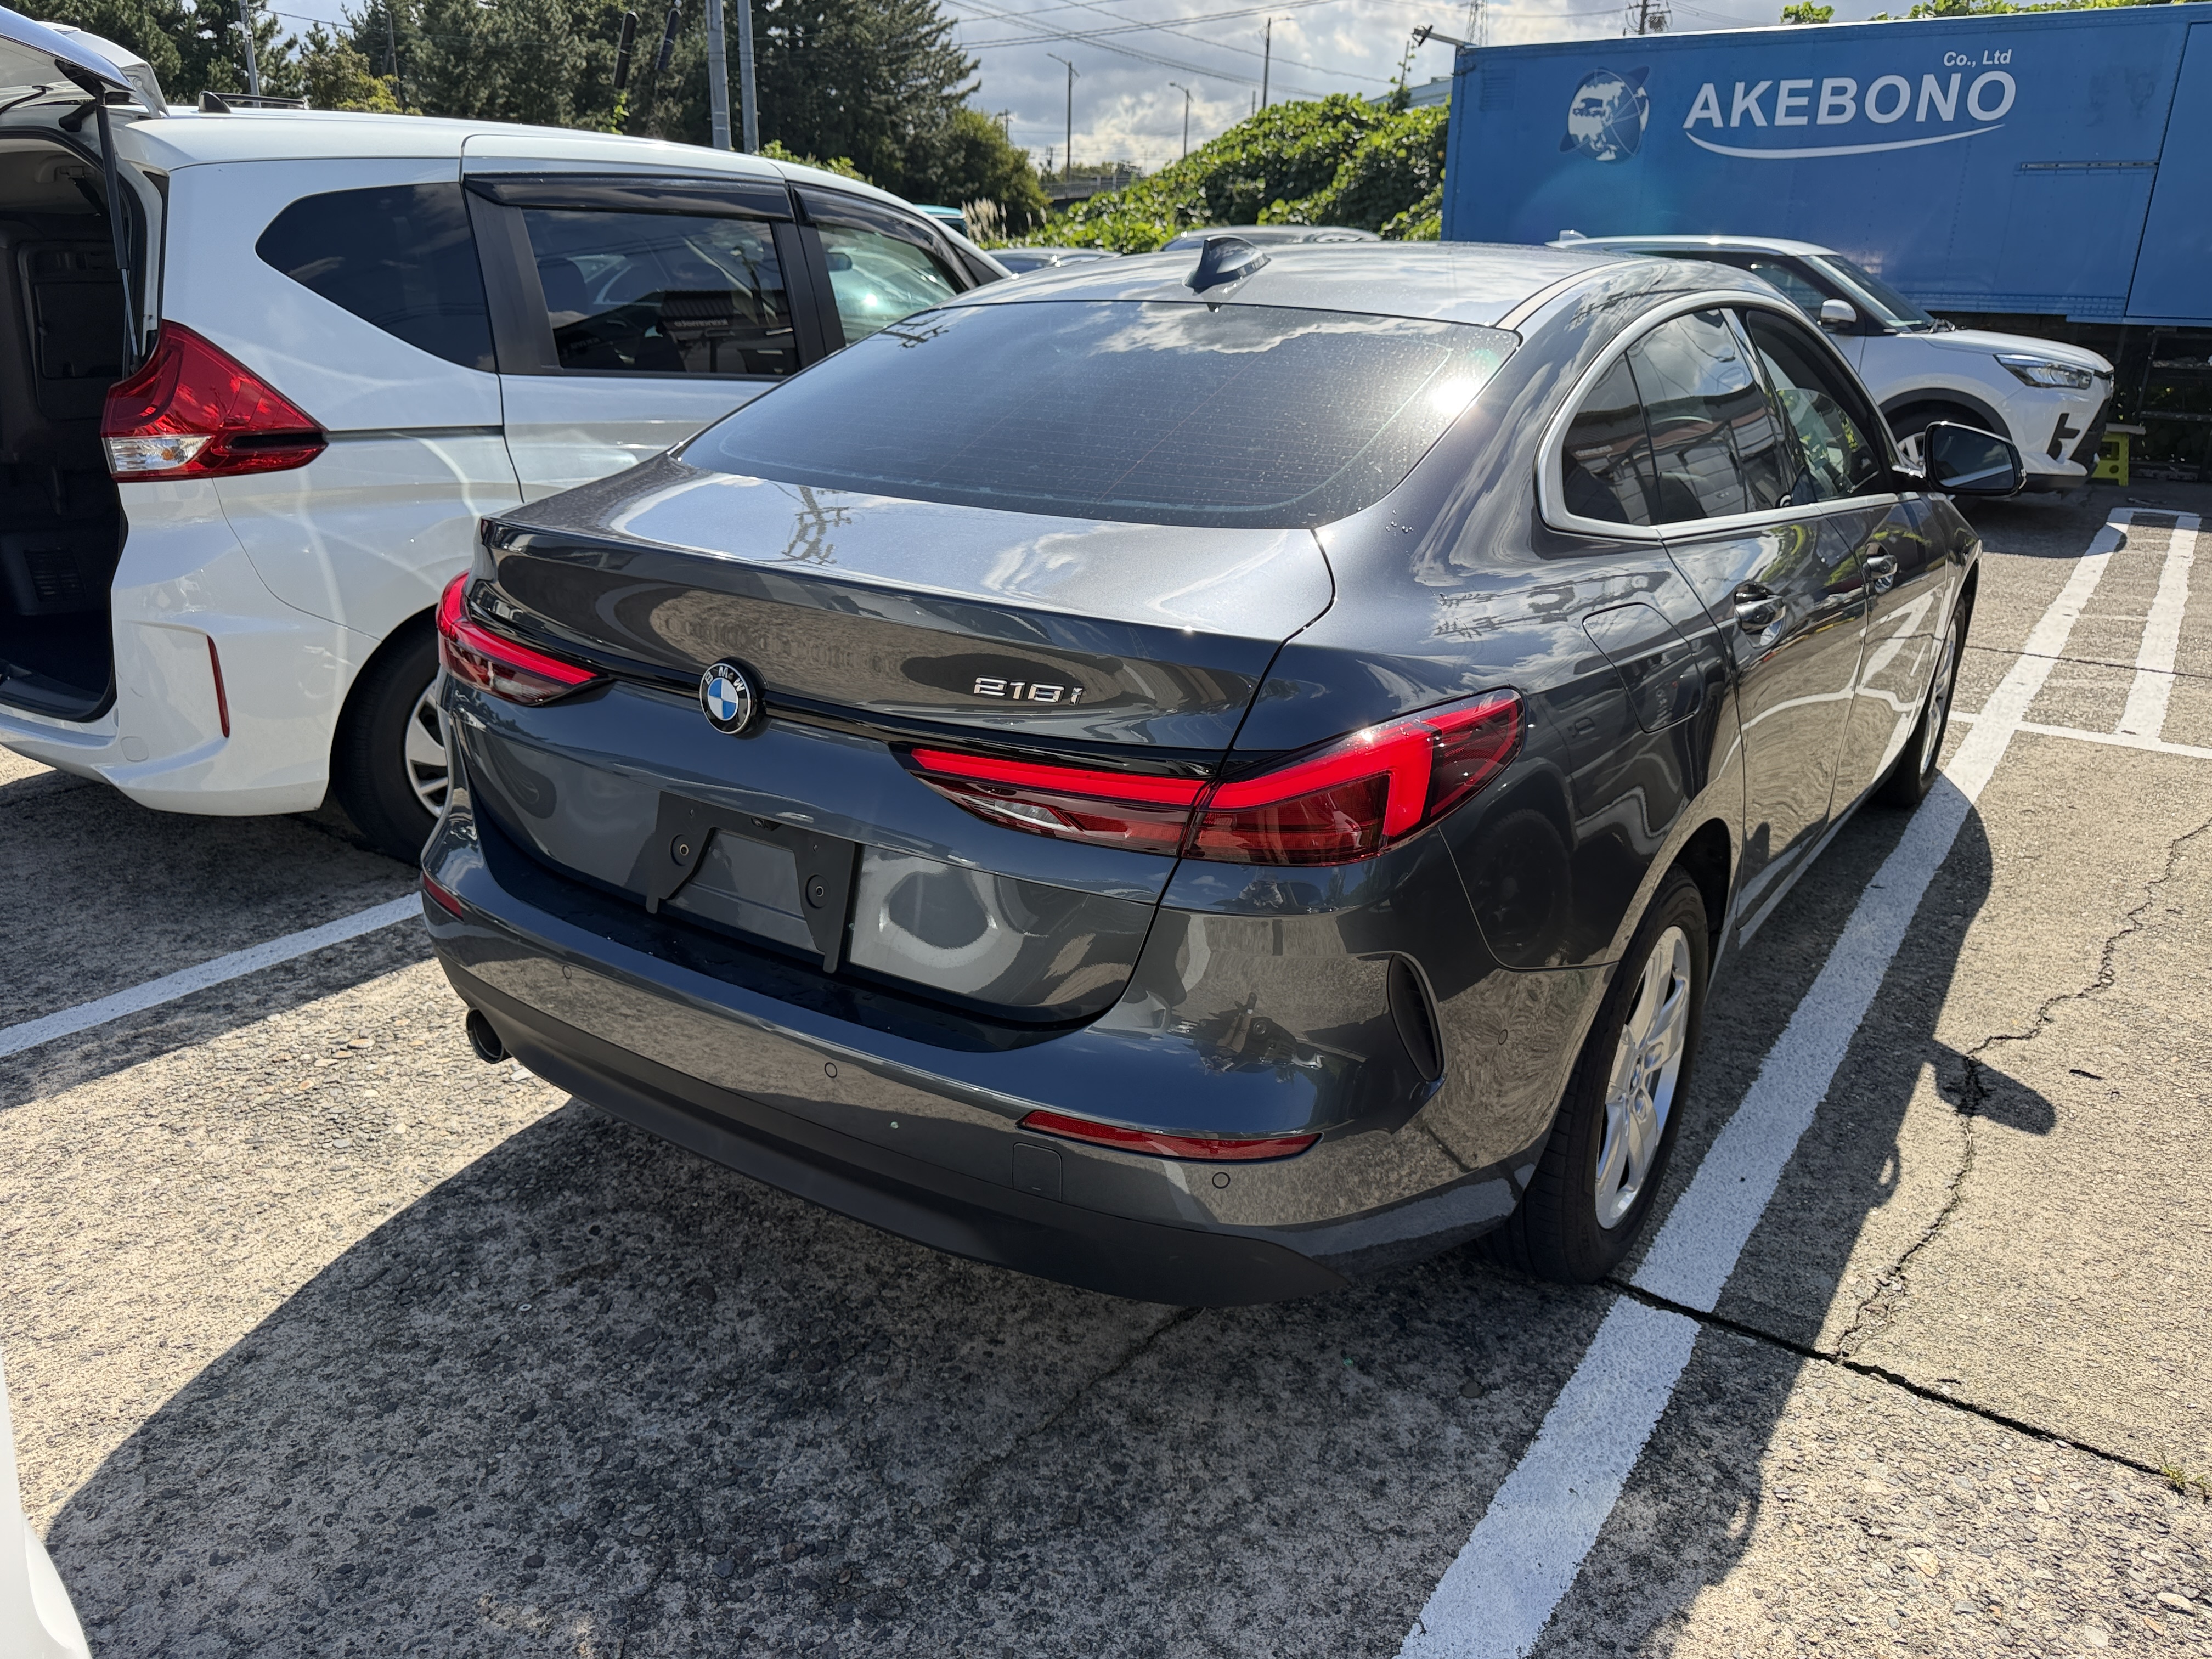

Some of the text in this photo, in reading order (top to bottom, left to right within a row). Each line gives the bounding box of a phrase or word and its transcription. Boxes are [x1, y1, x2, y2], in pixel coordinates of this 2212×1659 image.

[1943, 48, 2012, 68] Co., Ltd
[1682, 70, 2016, 129] AKEBONO
[704, 665, 745, 692] BMW
[973, 676, 1084, 706] 218i
